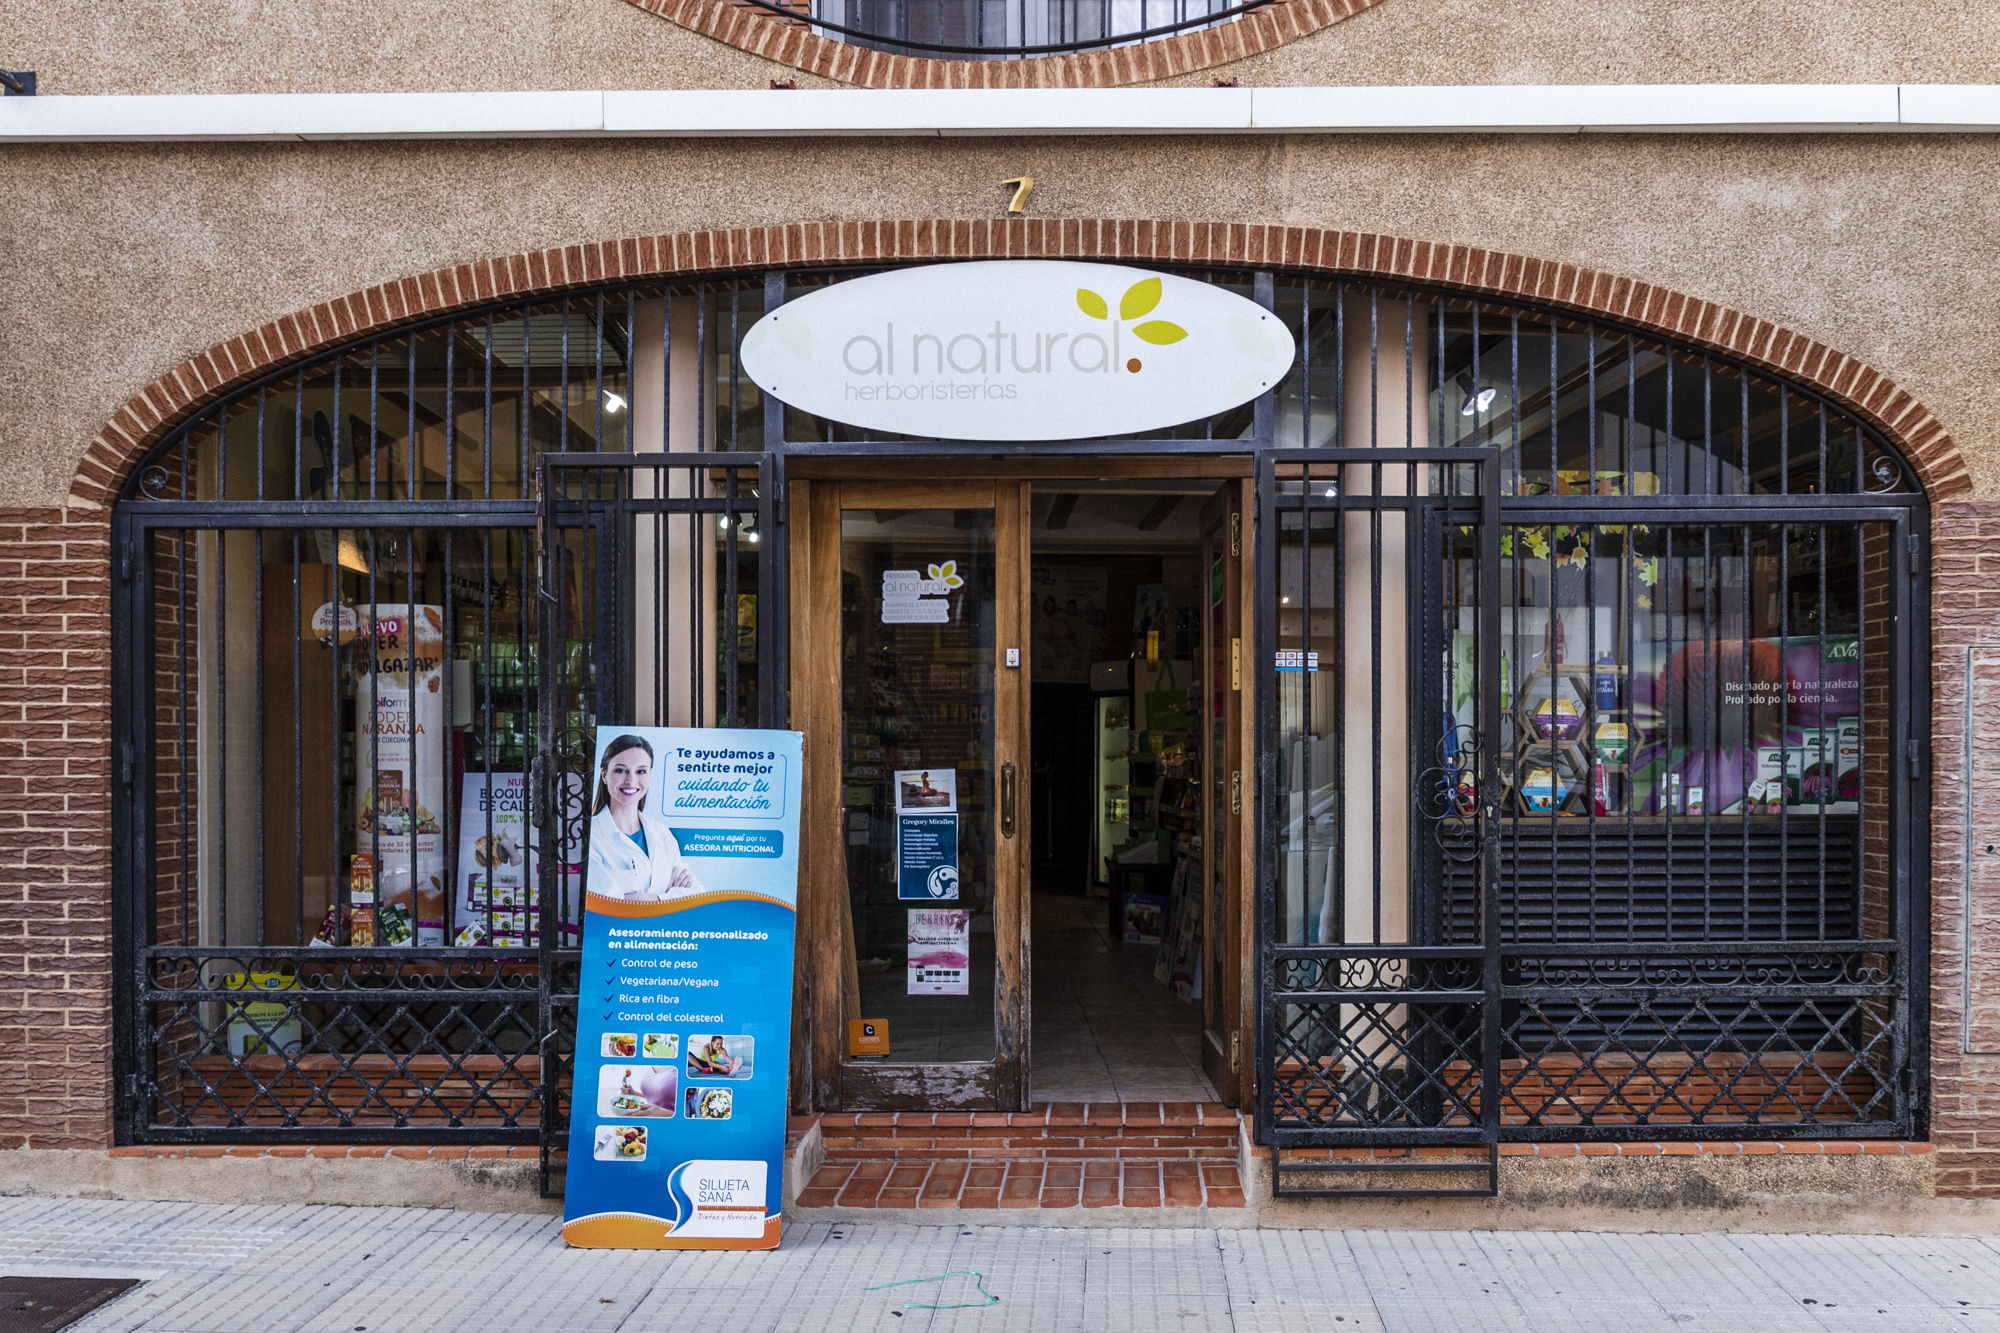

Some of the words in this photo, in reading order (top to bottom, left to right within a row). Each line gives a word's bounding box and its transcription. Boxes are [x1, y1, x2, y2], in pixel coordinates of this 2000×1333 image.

[1001, 176, 1034, 213] 7
[842, 322, 894, 376] al
[913, 319, 1121, 376] natural
[844, 377, 1018, 402] herboristerías
[885, 581, 897, 593] al
[899, 580, 943, 593] natural
[320, 617, 352, 627] Próolis
[357, 635, 399, 651] POER
[1792, 680, 1802, 690] la
[1788, 694, 1796, 704] la
[1800, 693, 1838, 704] cienia.
[362, 723, 426, 735] NRANA
[676, 748, 692, 758] Te
[695, 748, 764, 761] ayudamos
[766, 751, 775, 760] a
[677, 762, 730, 774] sentirte
[733, 763, 774, 776] mejor
[678, 778, 751, 792] cuidando
[752, 779, 770, 792] tu
[674, 794, 772, 810] alimentación
[496, 814, 518, 824] 100%
[902, 818, 928, 827] Gregory
[694, 833, 726, 843] Pregunta
[726, 833, 746, 844] aquí
[684, 844, 721, 852] ASESORA
[722, 844, 776, 854] NUTRICIONAL
[608, 928, 690, 939] Asesoramiento
[692, 930, 768, 941] personalizado
[608, 940, 622, 950] en
[624, 940, 698, 950] alimentación:
[621, 958, 658, 968] Control
[660, 958, 672, 968] de
[674, 960, 698, 970] peso
[620, 976, 719, 988] Vegetariana/Vegana
[618, 994, 640, 1004] Rica
[642, 996, 654, 1004] en
[656, 994, 680, 1004] fibra
[618, 1012, 654, 1022] Control
[656, 1012, 672, 1022] del
[674, 1013, 724, 1023] colesterol
[699, 1178, 750, 1191] SILUETA
[698, 1191, 733, 1203] SANA
[698, 1212, 720, 1220] Dietas
[726, 1212, 758, 1221] Nutrición
